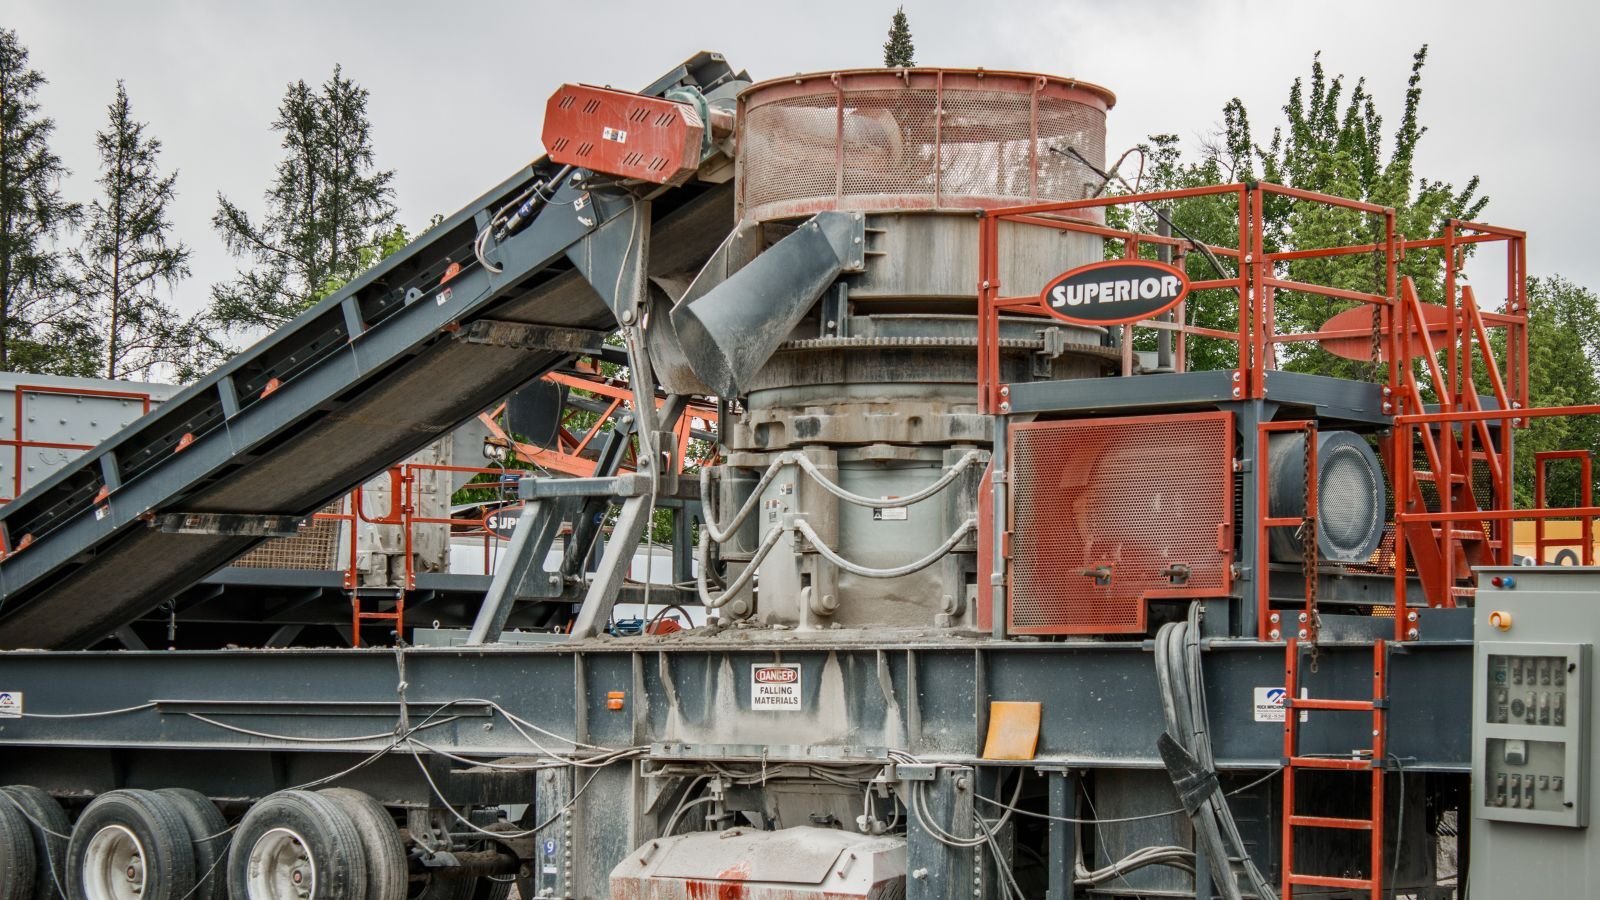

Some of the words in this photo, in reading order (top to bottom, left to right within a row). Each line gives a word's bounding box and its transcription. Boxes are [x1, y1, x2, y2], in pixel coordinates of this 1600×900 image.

[1052, 275, 1178, 307] SUPERIOR
[489, 516, 520, 530] SUP
[759, 670, 794, 681] DANGER
[760, 686, 792, 695] FALLING
[754, 696, 798, 705] MATERIALS
[546, 841, 554, 853] 9
